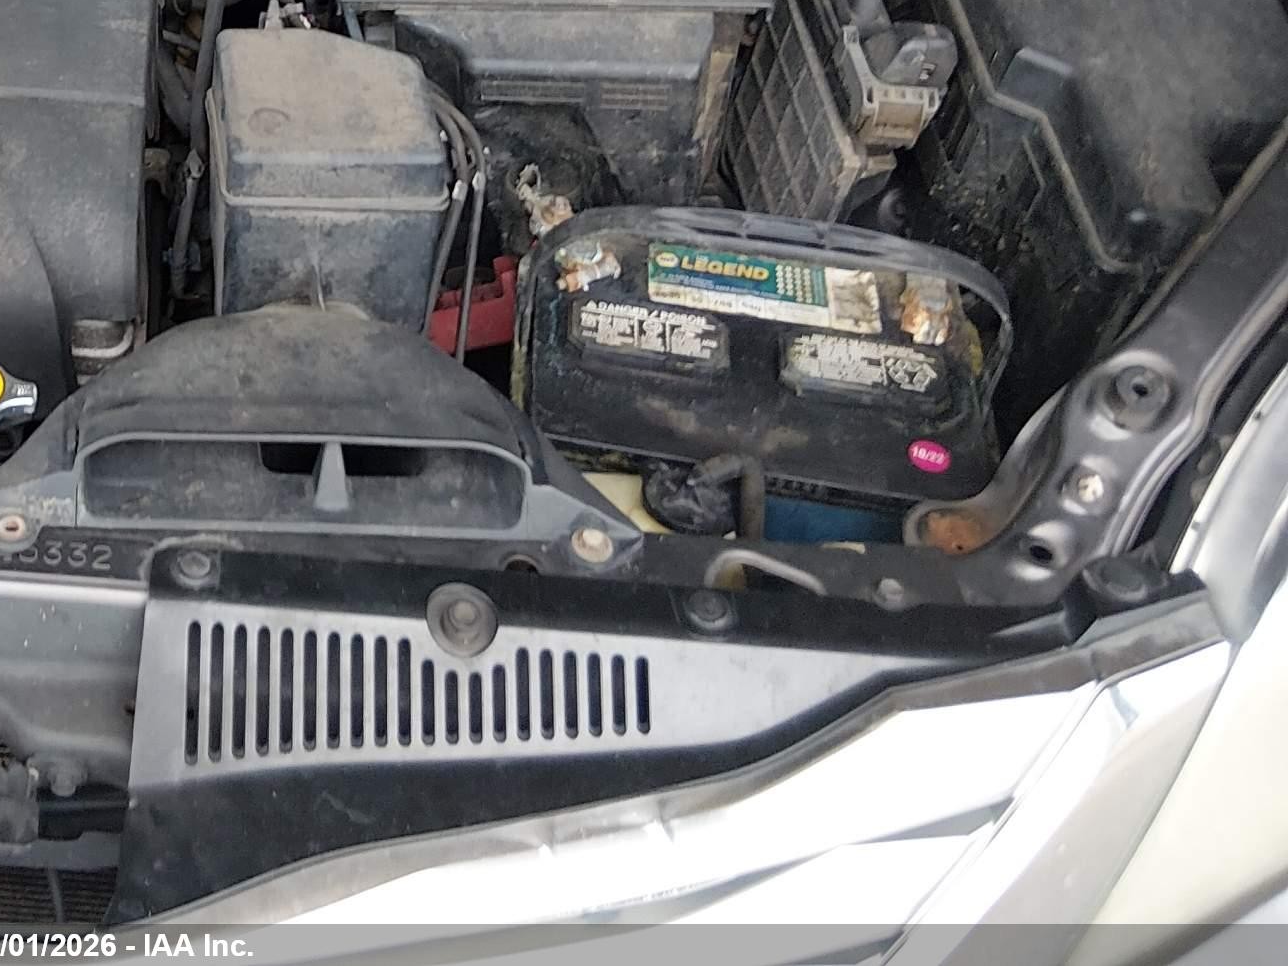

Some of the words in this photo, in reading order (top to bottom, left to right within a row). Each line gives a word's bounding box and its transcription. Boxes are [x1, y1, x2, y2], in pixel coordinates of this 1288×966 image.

[680, 255, 770, 281] LEGEND
[597, 300, 649, 318] DANGER
[659, 311, 708, 326] POISON
